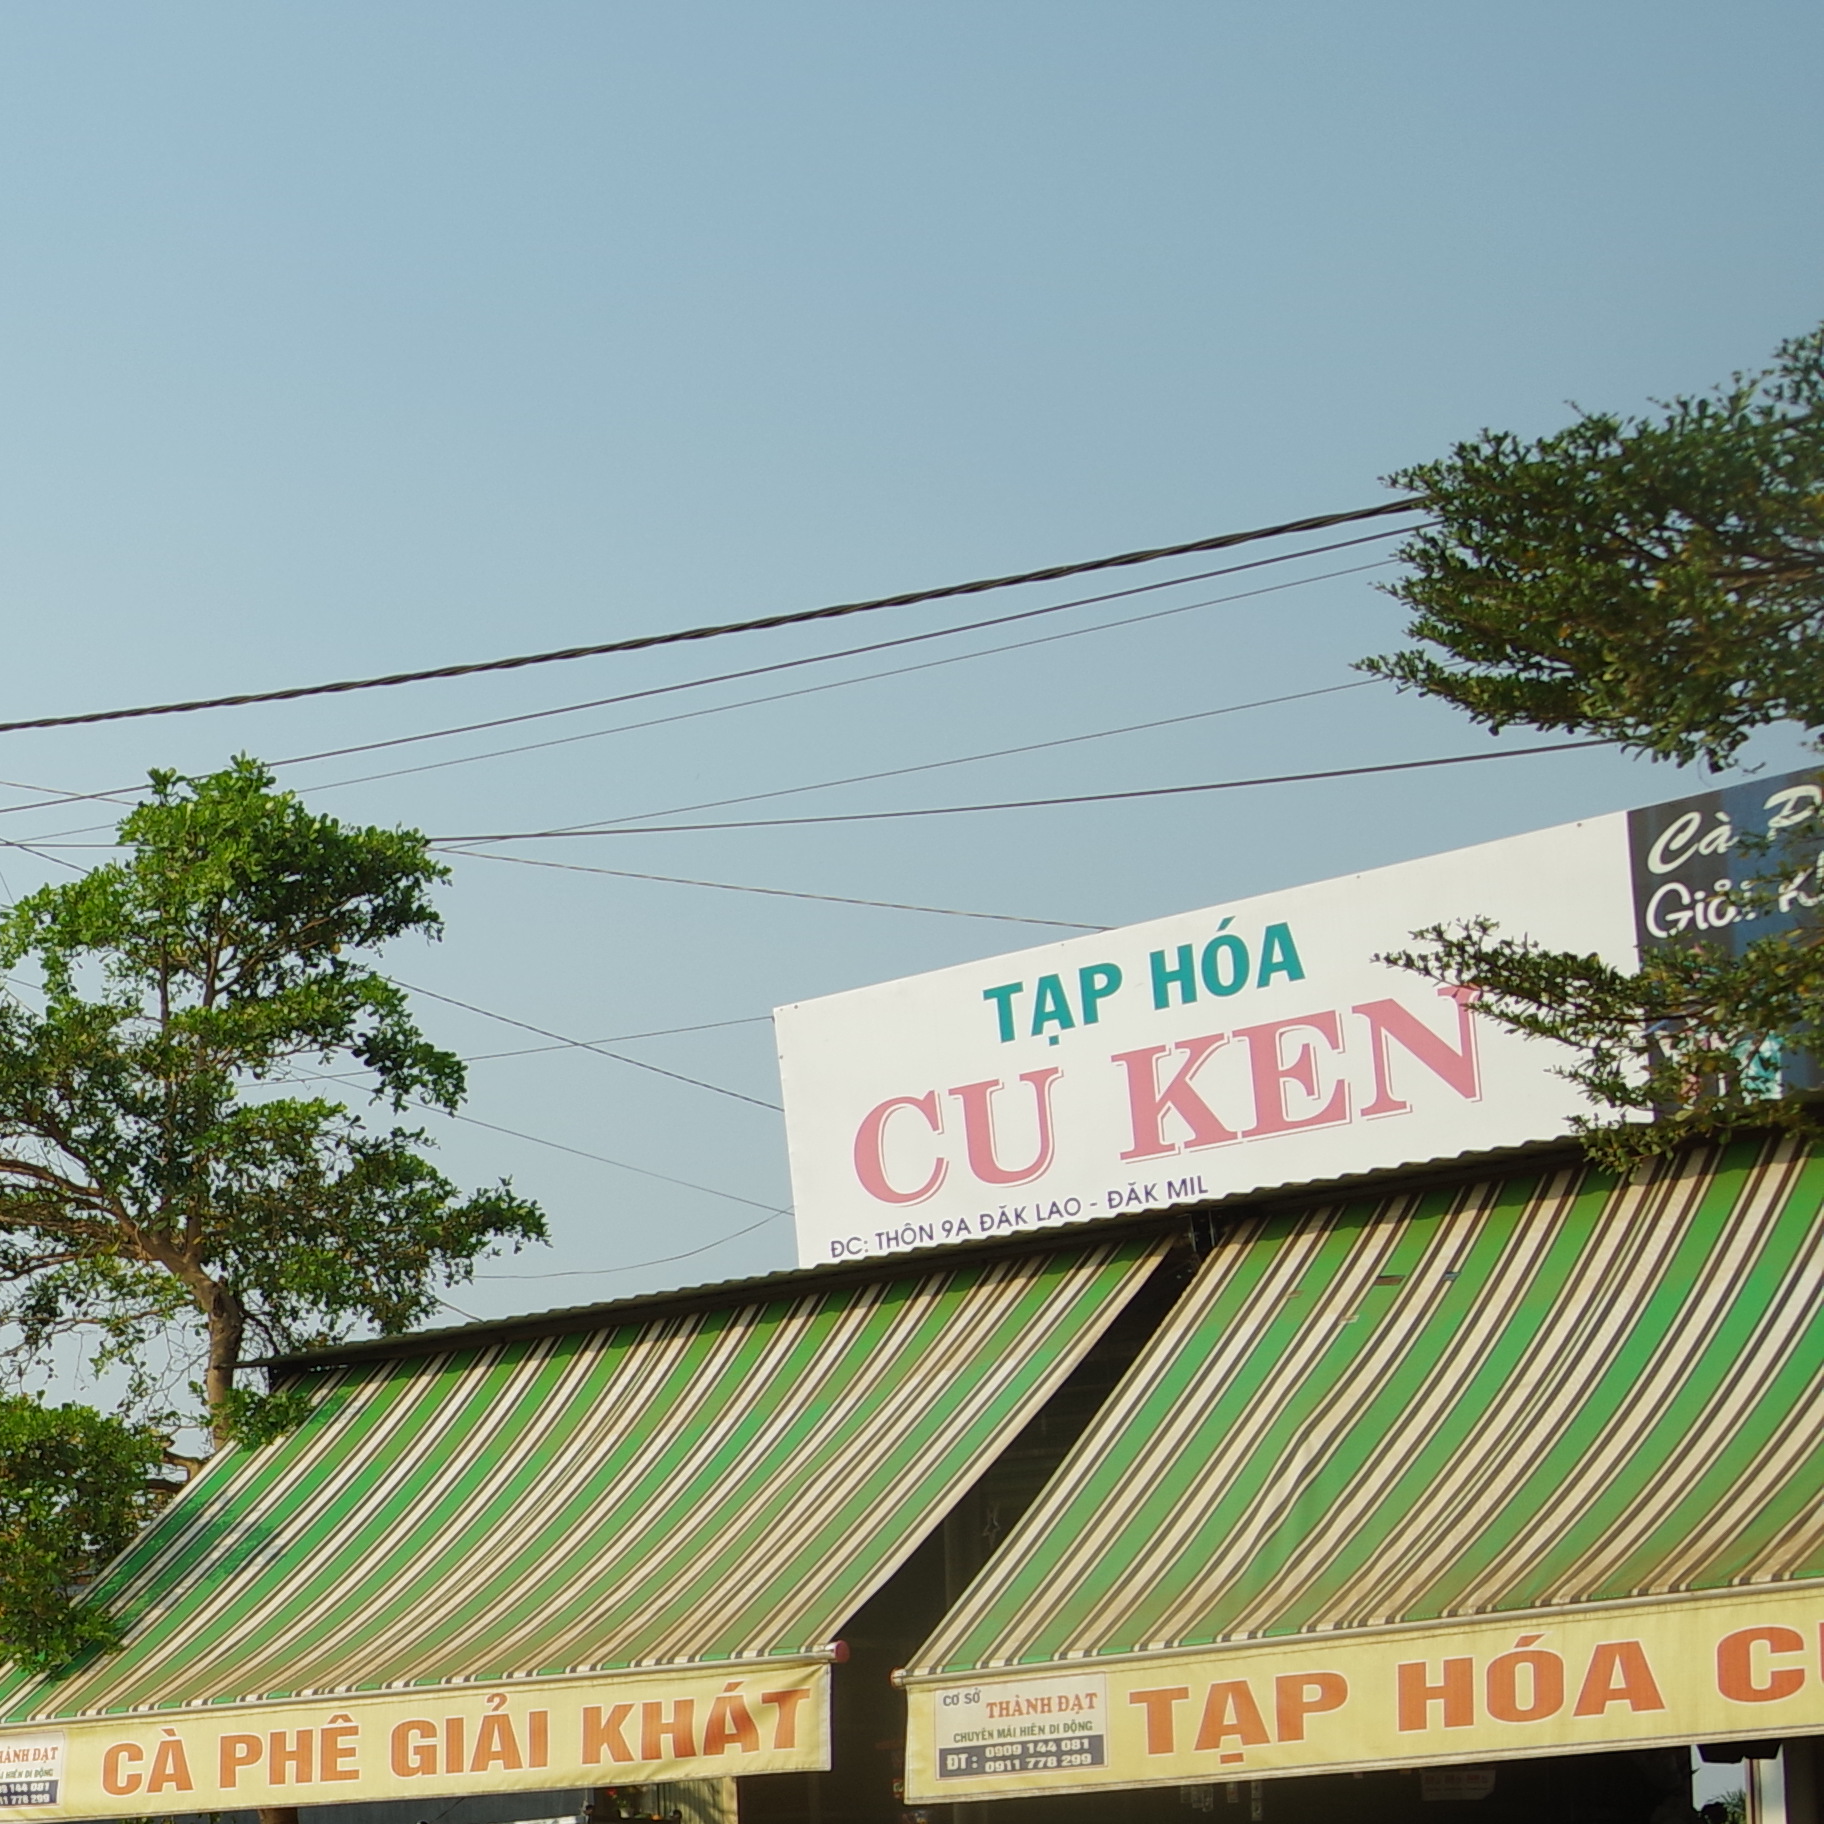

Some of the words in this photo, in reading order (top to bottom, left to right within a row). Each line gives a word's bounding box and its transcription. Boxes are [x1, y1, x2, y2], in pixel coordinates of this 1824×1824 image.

[1647, 811, 1739, 875] Cà
[983, 961, 1122, 1046] TẠP
[1151, 916, 1306, 1011] HÓA
[853, 1065, 1064, 1208] CU
[1111, 985, 1483, 1164] KEN
[830, 1240, 869, 1259] ĐC:
[875, 1222, 934, 1252] THÔN
[940, 1218, 972, 1239] 9A
[1036, 1196, 1082, 1223] LAO
[1167, 1174, 1209, 1200] MIL
[986, 1694, 1052, 1719] THÀNH
[1057, 1692, 1097, 1715] ĐẠT
[1049, 1723, 1059, 1734] DI
[1127, 1671, 1350, 1765] TẠP
[1396, 1634, 1665, 1733] HÓA
[1715, 1620, 1824, 1706] C
[101, 1726, 194, 1797] CÀ
[219, 1713, 362, 1790] PHÊ
[389, 1691, 551, 1779] GIẢI
[581, 1679, 812, 1765] KHÁT
[985, 1744, 1022, 1758] 0909
[1027, 1741, 1057, 1754] 144
[1061, 1738, 1090, 1751] 081
[985, 1759, 1021, 1773] 0911
[1025, 1756, 1057, 1770] 778
[1061, 1753, 1092, 1767] 299
